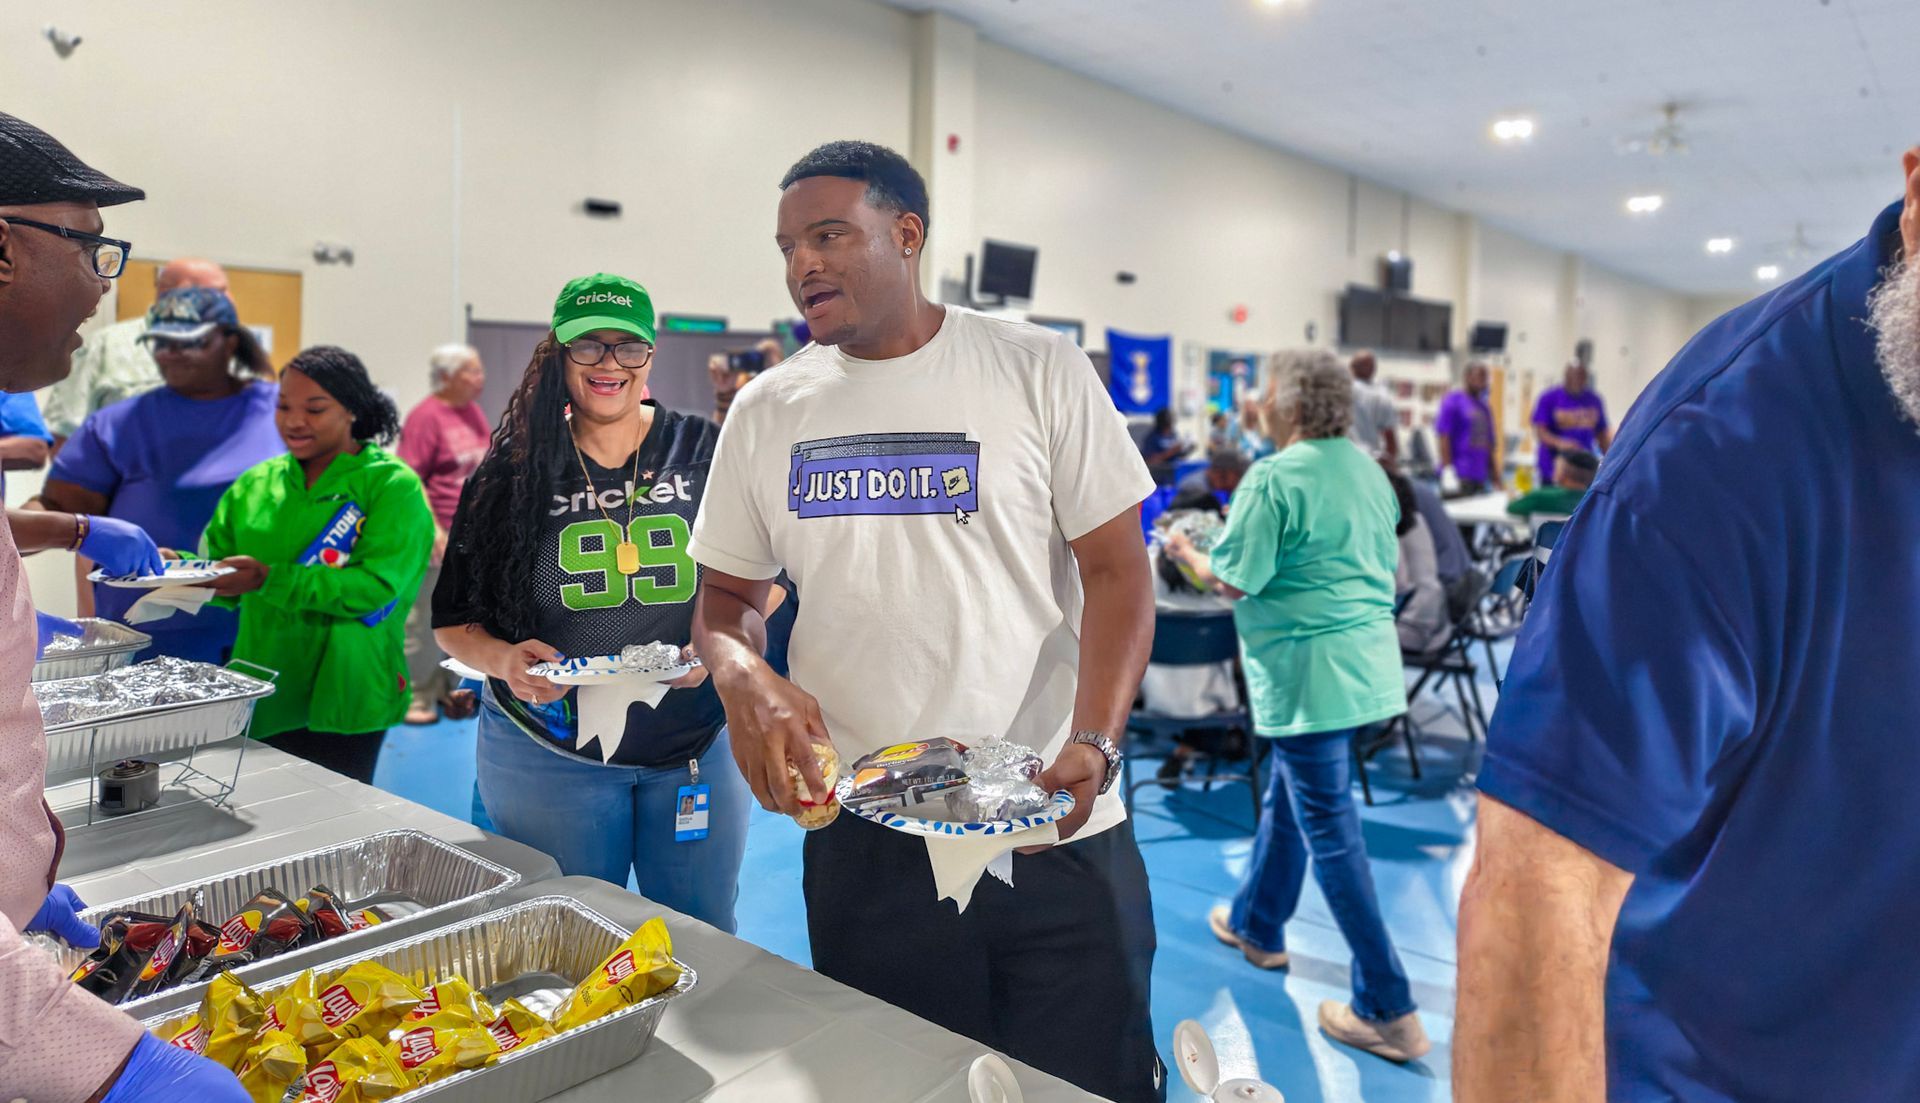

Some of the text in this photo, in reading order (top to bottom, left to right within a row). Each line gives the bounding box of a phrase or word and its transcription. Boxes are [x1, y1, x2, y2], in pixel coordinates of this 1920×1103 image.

[576, 291, 633, 308] cricket
[549, 474, 692, 517] cricket
[803, 468, 863, 502] JUST
[867, 467, 907, 500] DO
[909, 466, 939, 499] IT.
[558, 513, 698, 612] 99
